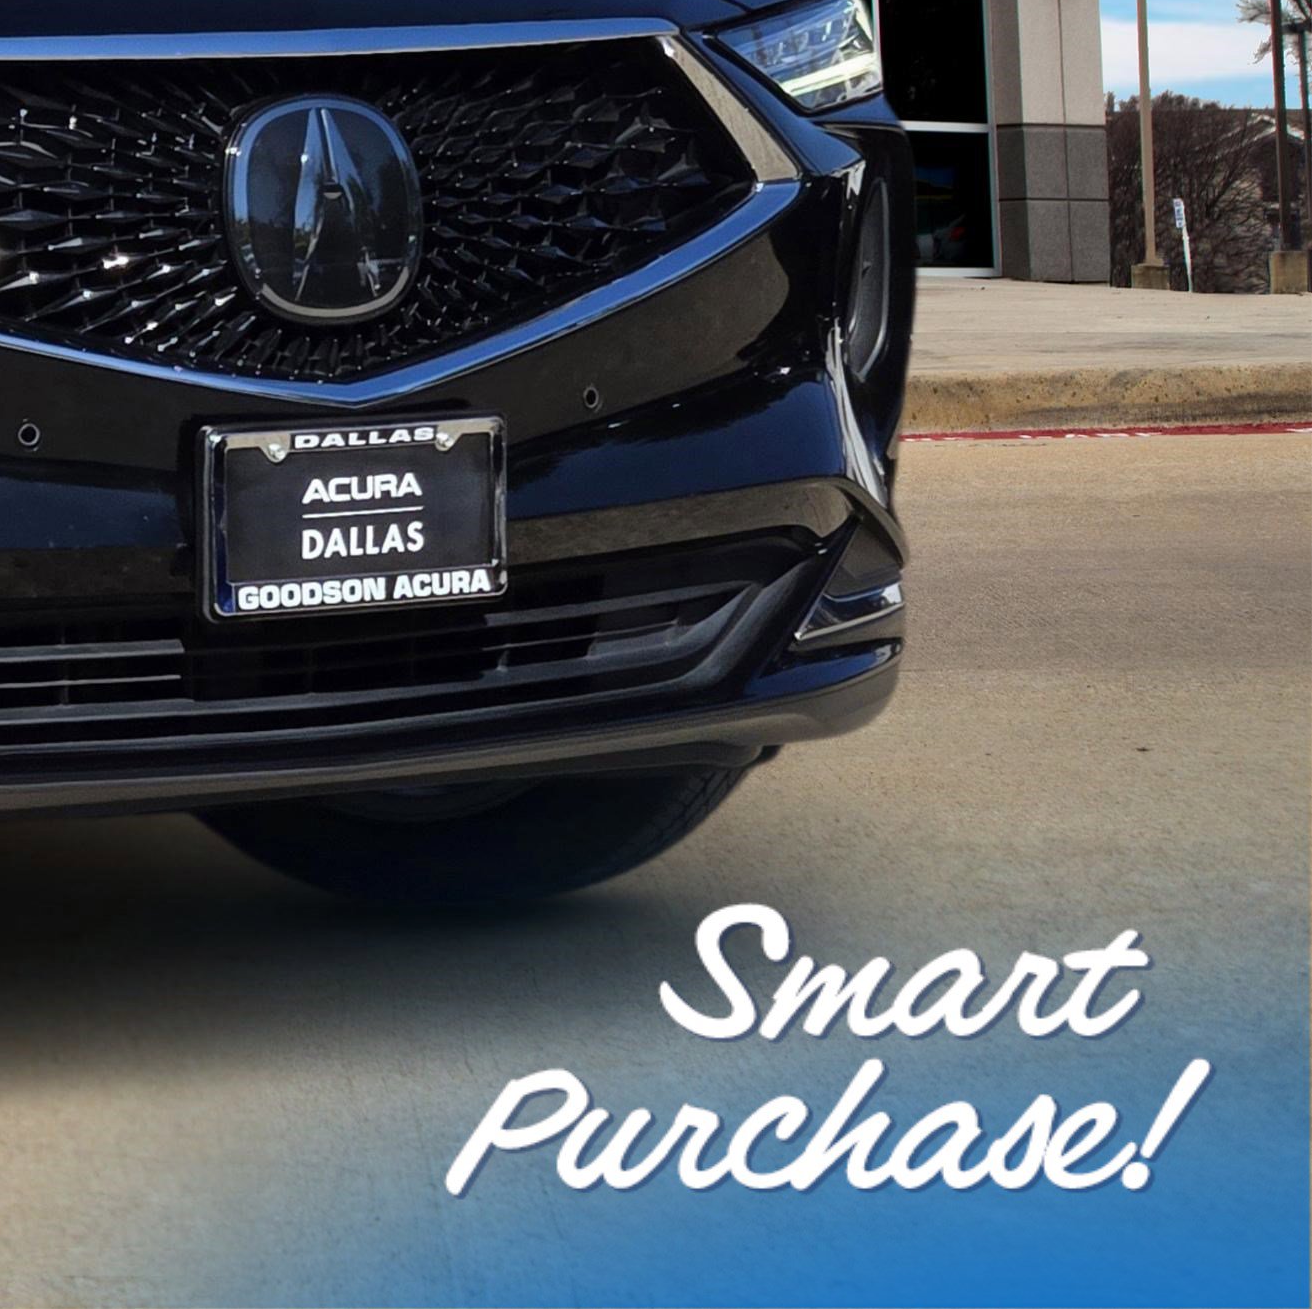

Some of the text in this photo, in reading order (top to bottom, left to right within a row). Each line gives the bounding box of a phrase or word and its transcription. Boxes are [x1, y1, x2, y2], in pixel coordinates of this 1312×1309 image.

[294, 427, 435, 450] DALLAS
[301, 472, 423, 504] ACURA
[301, 521, 425, 560] DALLAS
[237, 569, 492, 611] GOODSON ACURA
